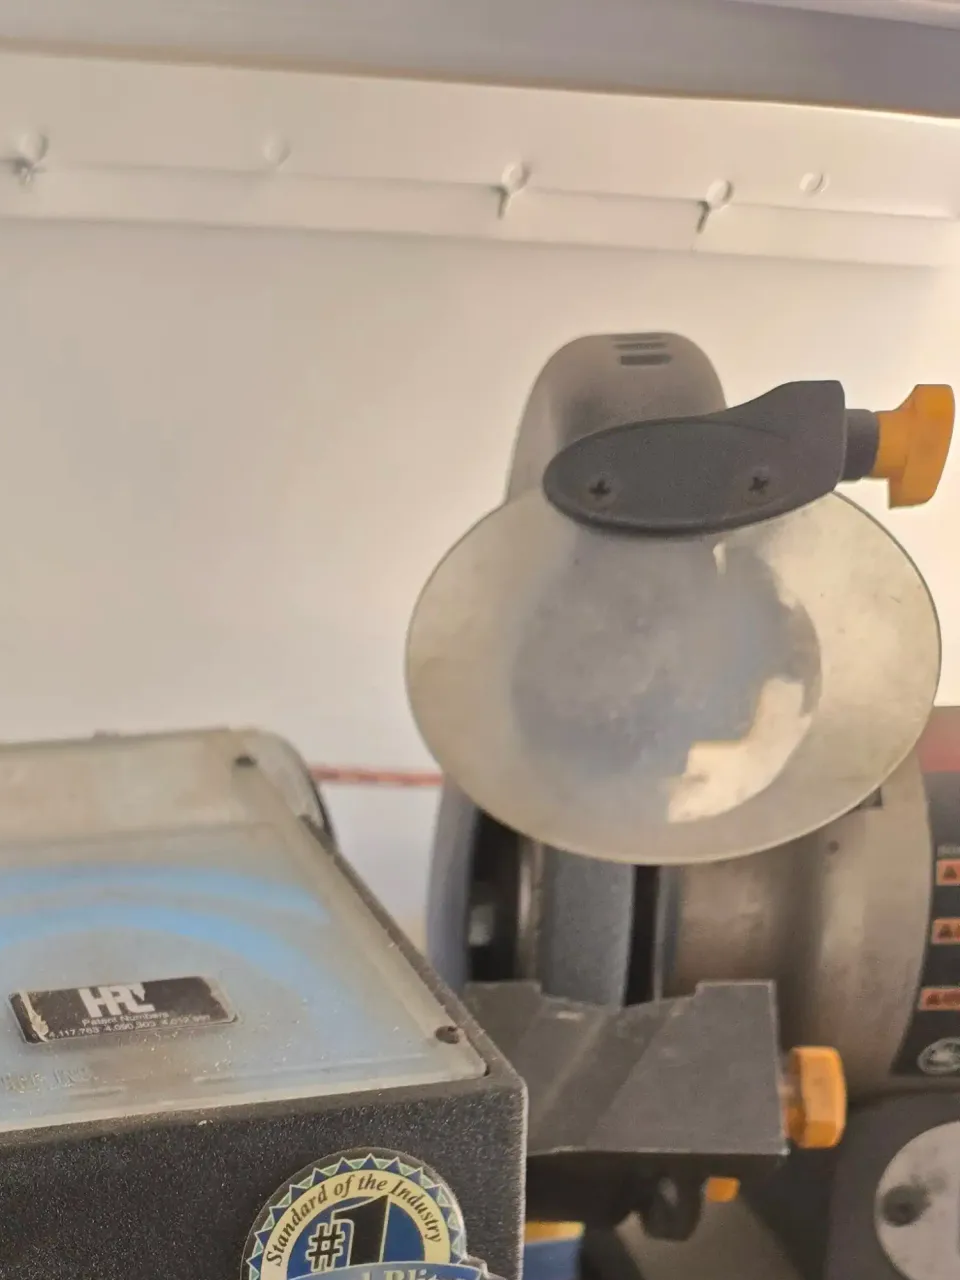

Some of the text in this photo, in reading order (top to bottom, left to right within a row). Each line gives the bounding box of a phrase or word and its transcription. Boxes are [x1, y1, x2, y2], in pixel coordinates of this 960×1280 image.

[81, 1012, 169, 1027] Patent Numbers
[265, 1174, 444, 1267] Standard of the Industry
